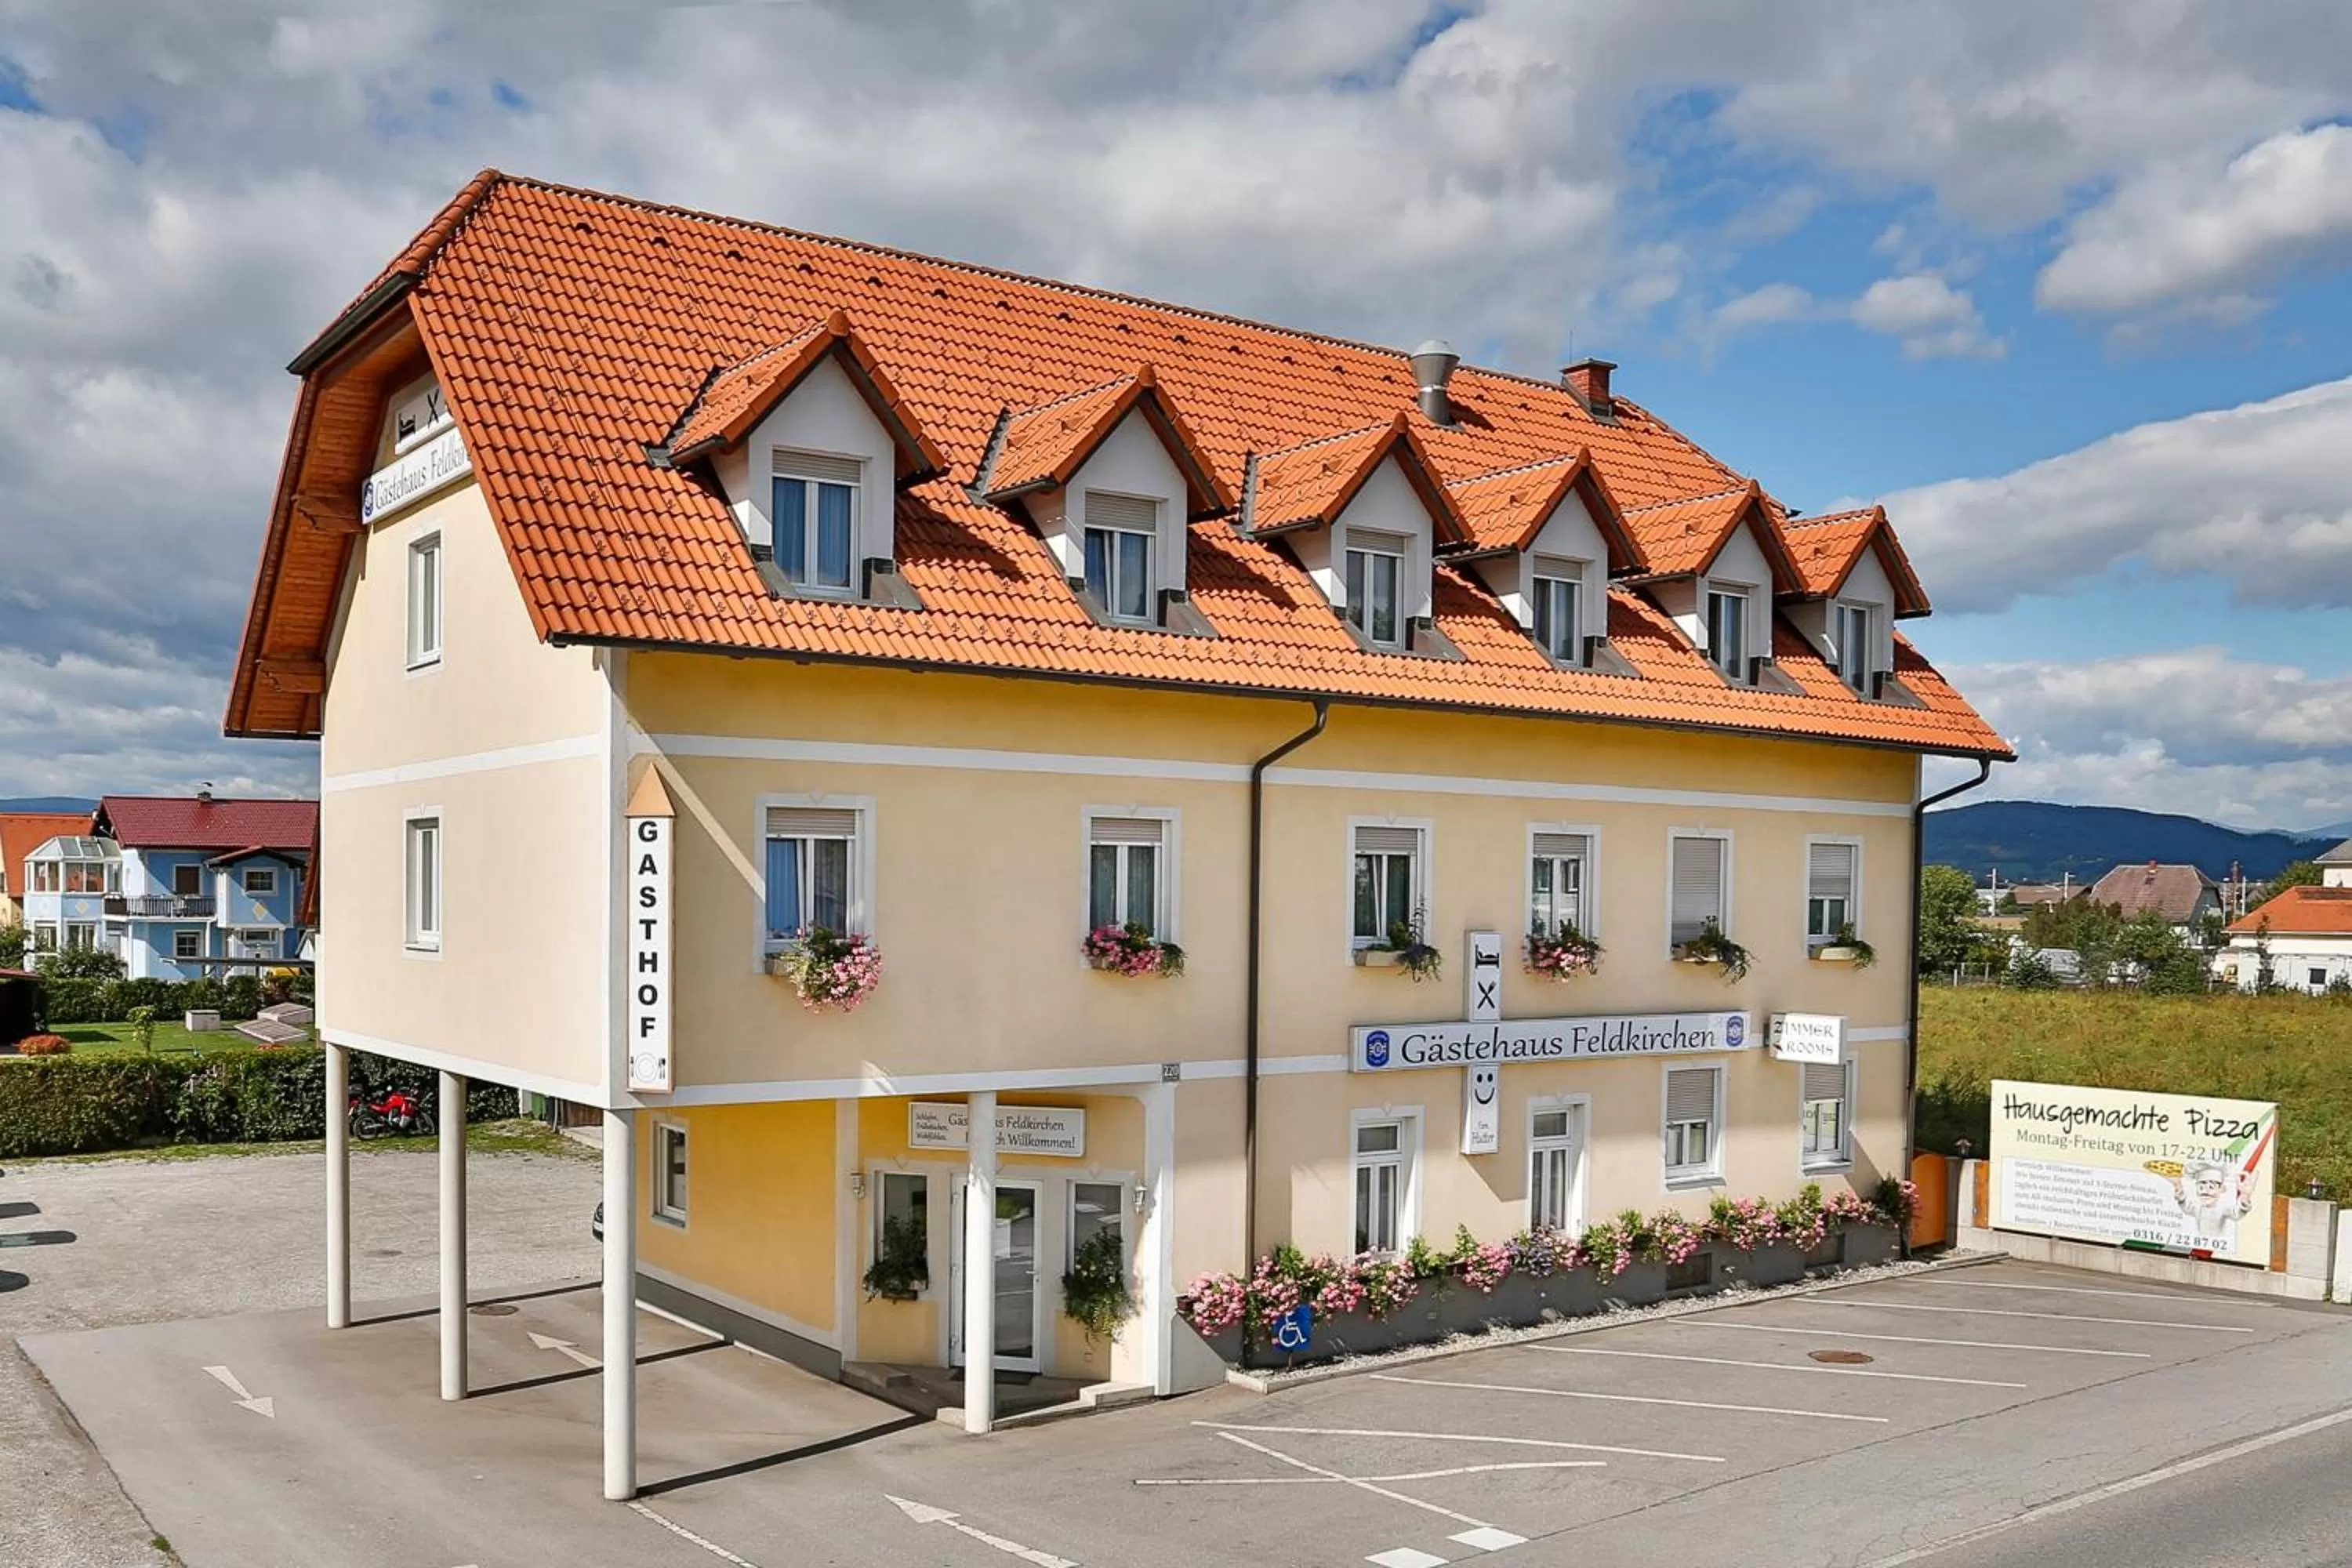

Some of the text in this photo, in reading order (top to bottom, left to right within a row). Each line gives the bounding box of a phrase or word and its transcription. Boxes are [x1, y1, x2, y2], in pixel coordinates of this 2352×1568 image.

[637, 820, 658, 1038] GASTHOF
[1401, 1025, 1563, 1064] Gästehaus
[1570, 1019, 1715, 1054] Feldkirchen
[1773, 1021, 1835, 1038] ZIMMER
[1006, 1116, 1065, 1131] Feldkirchen
[2002, 1093, 2259, 1141] Hausgemachte Pizza
[1007, 1133, 1076, 1149] Willkommen!
[2016, 1129, 2241, 1163] Montag-Freitag von 17-22 Uhr
[2133, 1229, 2164, 1241] 0316
[2176, 1234, 2190, 1246] 22
[2194, 1236, 2209, 1247] 87
[2212, 1240, 2227, 1250] 02
